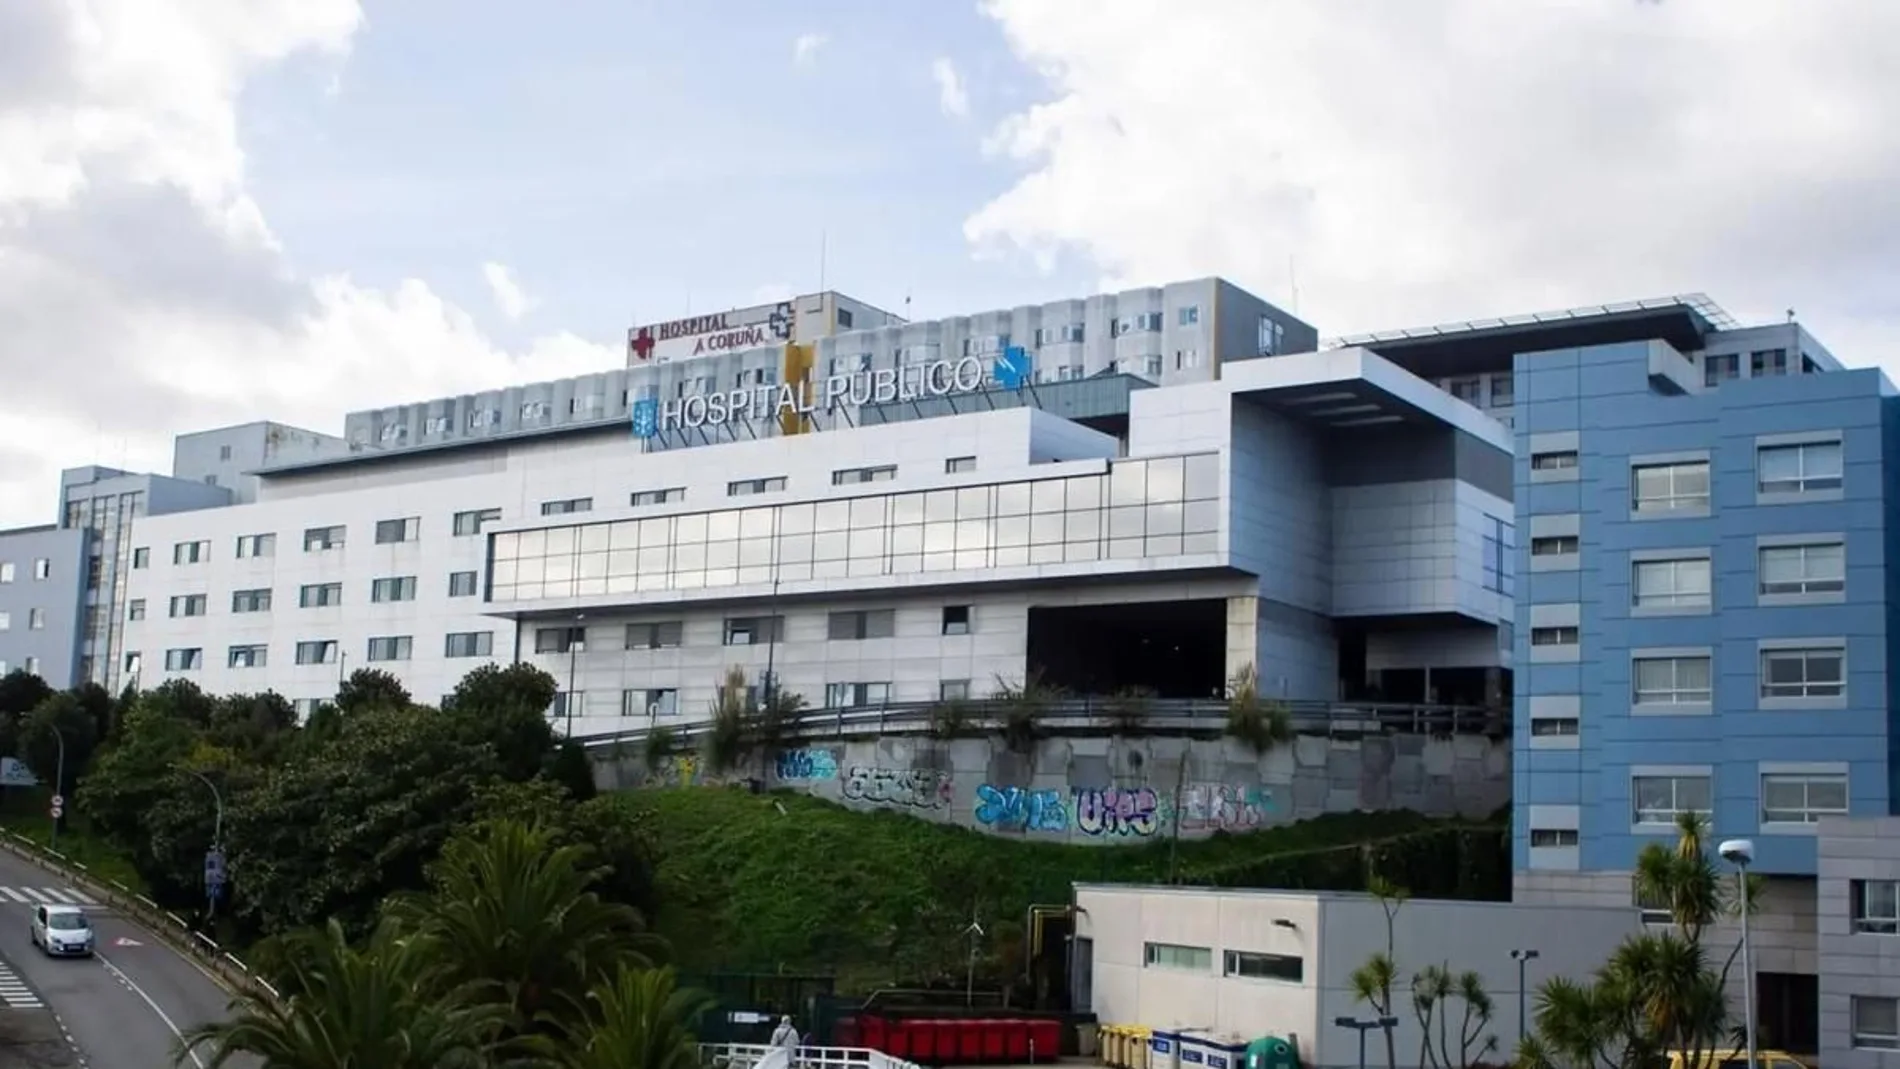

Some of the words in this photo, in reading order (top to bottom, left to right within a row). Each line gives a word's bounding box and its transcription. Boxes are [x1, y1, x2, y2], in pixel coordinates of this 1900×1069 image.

[659, 313, 729, 341] HOSPITAL
[693, 338, 704, 356] A
[708, 325, 764, 351] CORUÑA
[662, 380, 815, 431] HOSPITAL
[826, 355, 982, 409] PÚBLICO
